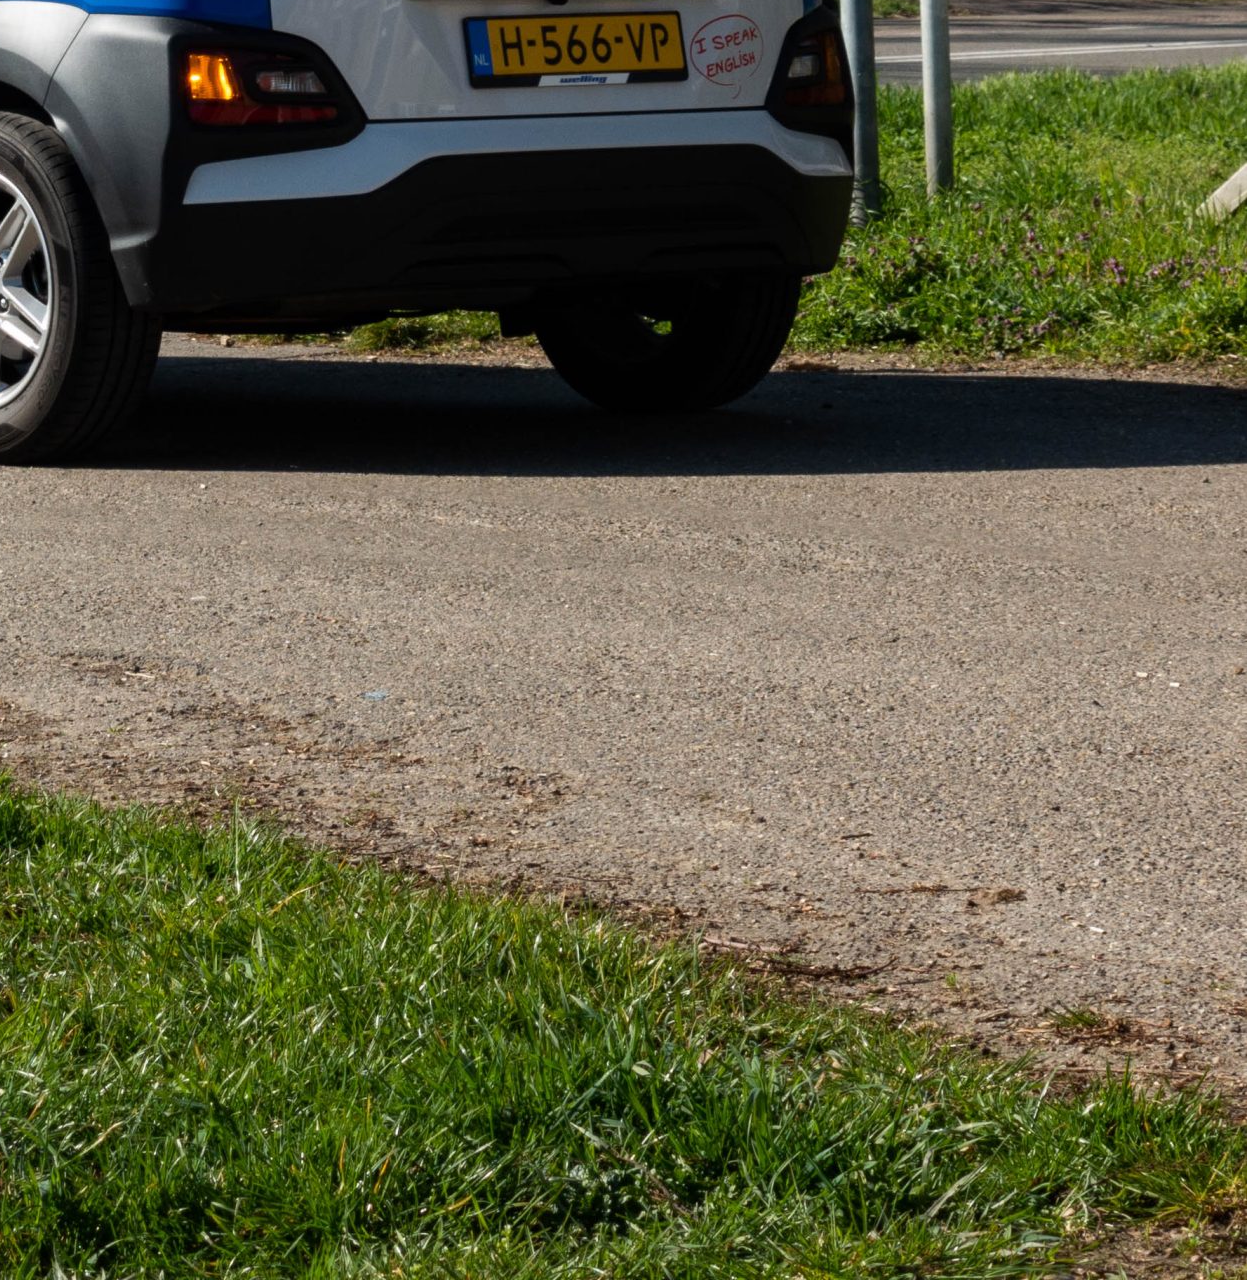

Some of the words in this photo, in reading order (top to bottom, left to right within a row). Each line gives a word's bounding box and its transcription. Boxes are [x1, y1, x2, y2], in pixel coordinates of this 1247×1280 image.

[499, 22, 669, 67] H-566-VP
[694, 36, 707, 55] I
[711, 26, 758, 50] SPEAK
[474, 54, 489, 67] NL
